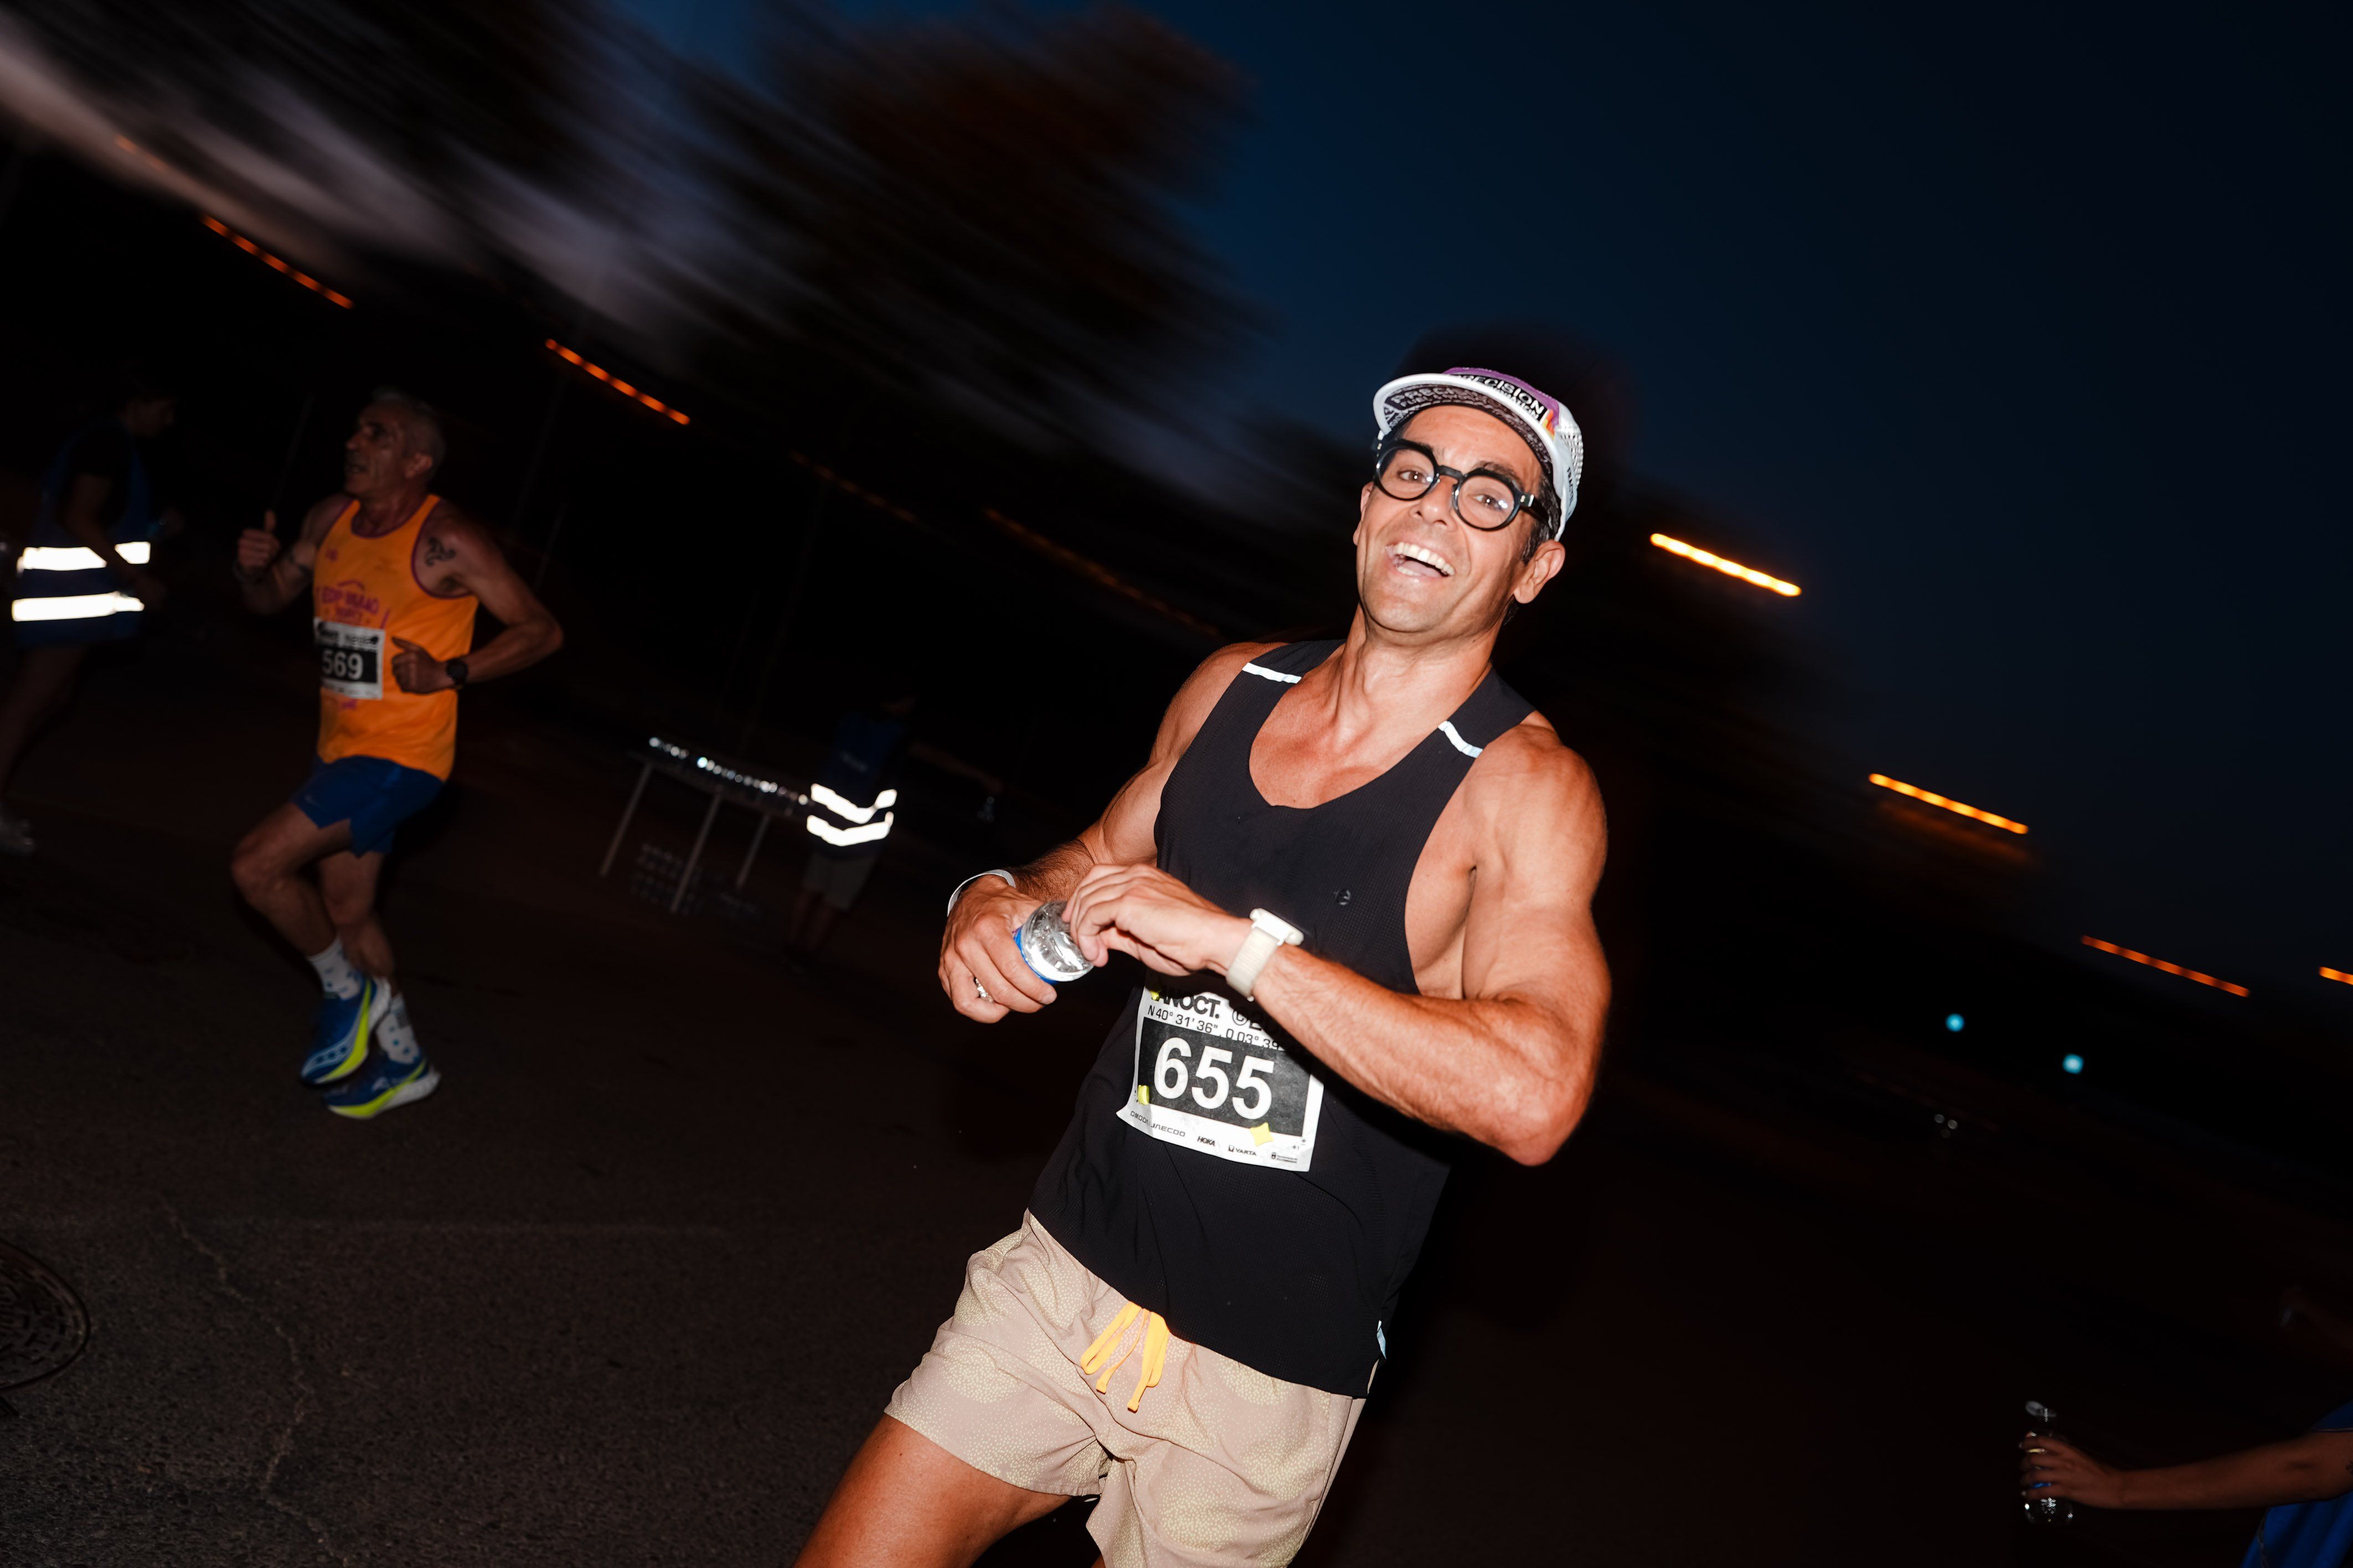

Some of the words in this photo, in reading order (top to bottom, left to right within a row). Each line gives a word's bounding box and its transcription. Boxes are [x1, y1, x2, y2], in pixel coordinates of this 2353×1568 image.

[322, 648, 364, 680] 569
[1148, 1005, 1155, 1016] N
[1154, 1037, 1275, 1120] 655
[1197, 1136, 1216, 1147] HOKA
[1235, 1148, 1257, 1157] VARTA
